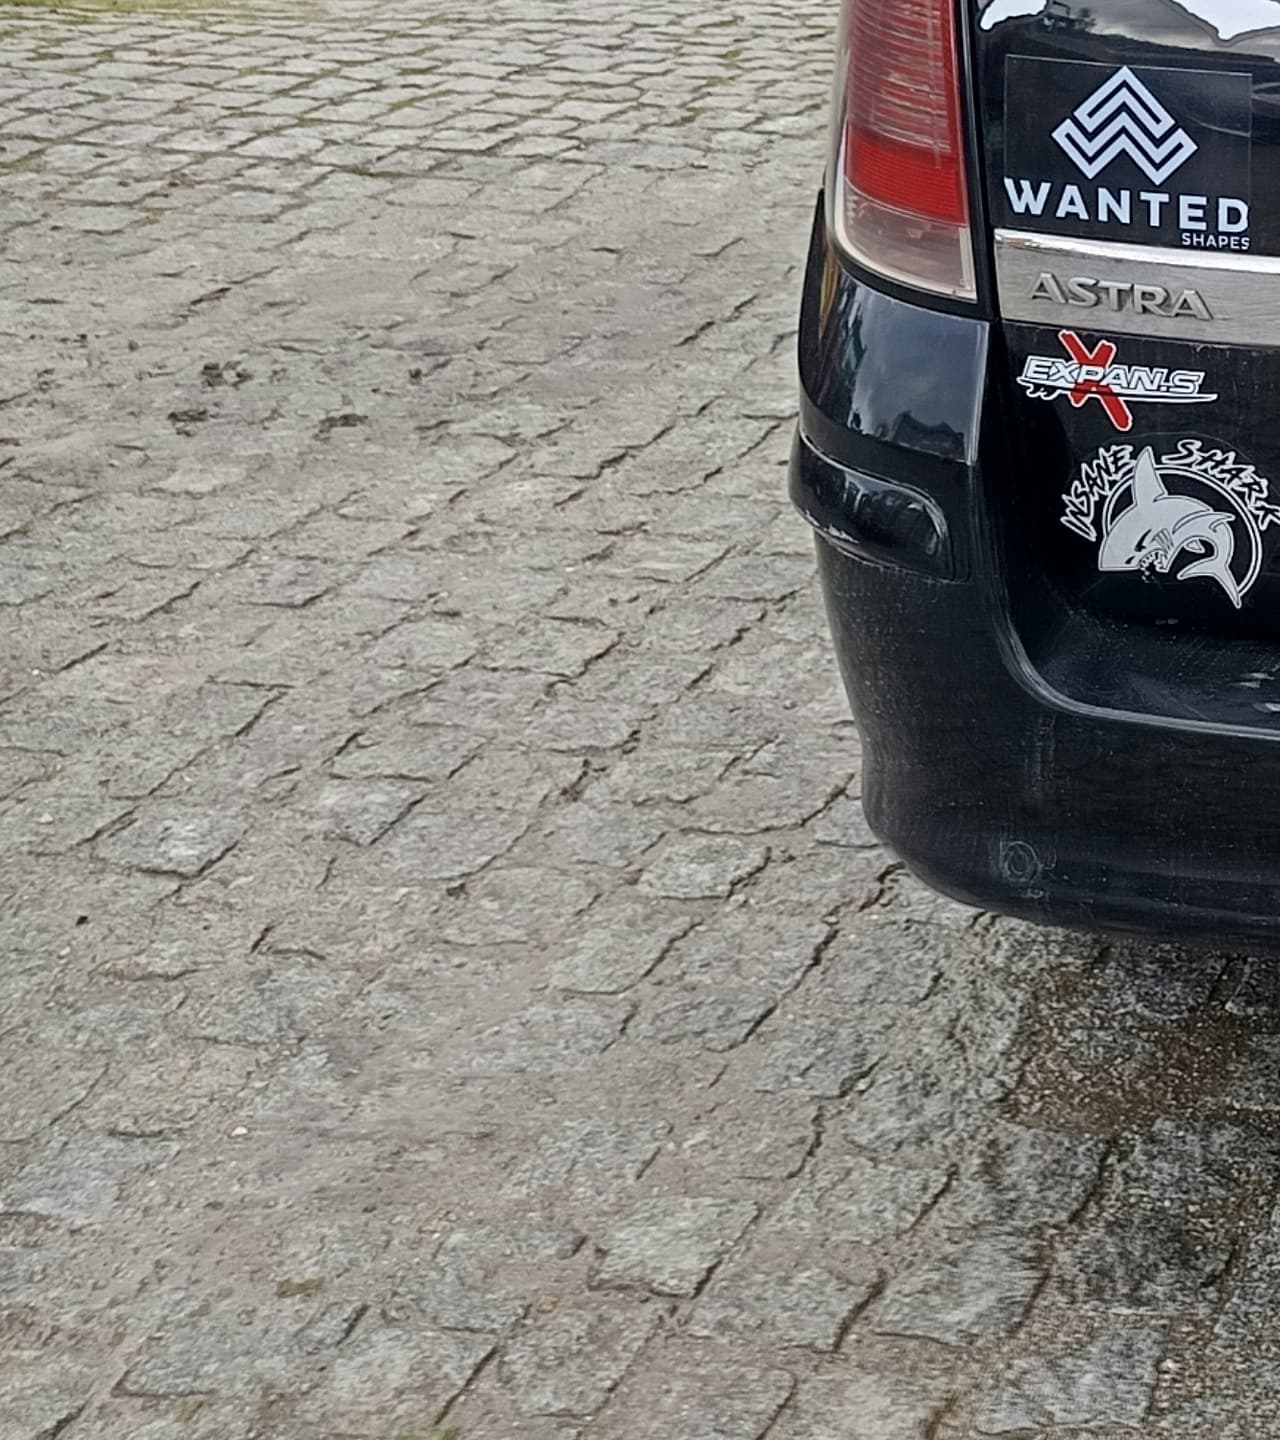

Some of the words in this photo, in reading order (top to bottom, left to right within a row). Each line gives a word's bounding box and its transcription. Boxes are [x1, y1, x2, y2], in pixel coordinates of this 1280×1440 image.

[1003, 176, 1251, 233] WANTED
[1181, 231, 1251, 250] SHAPES
[1030, 272, 1214, 321] ASTRA
